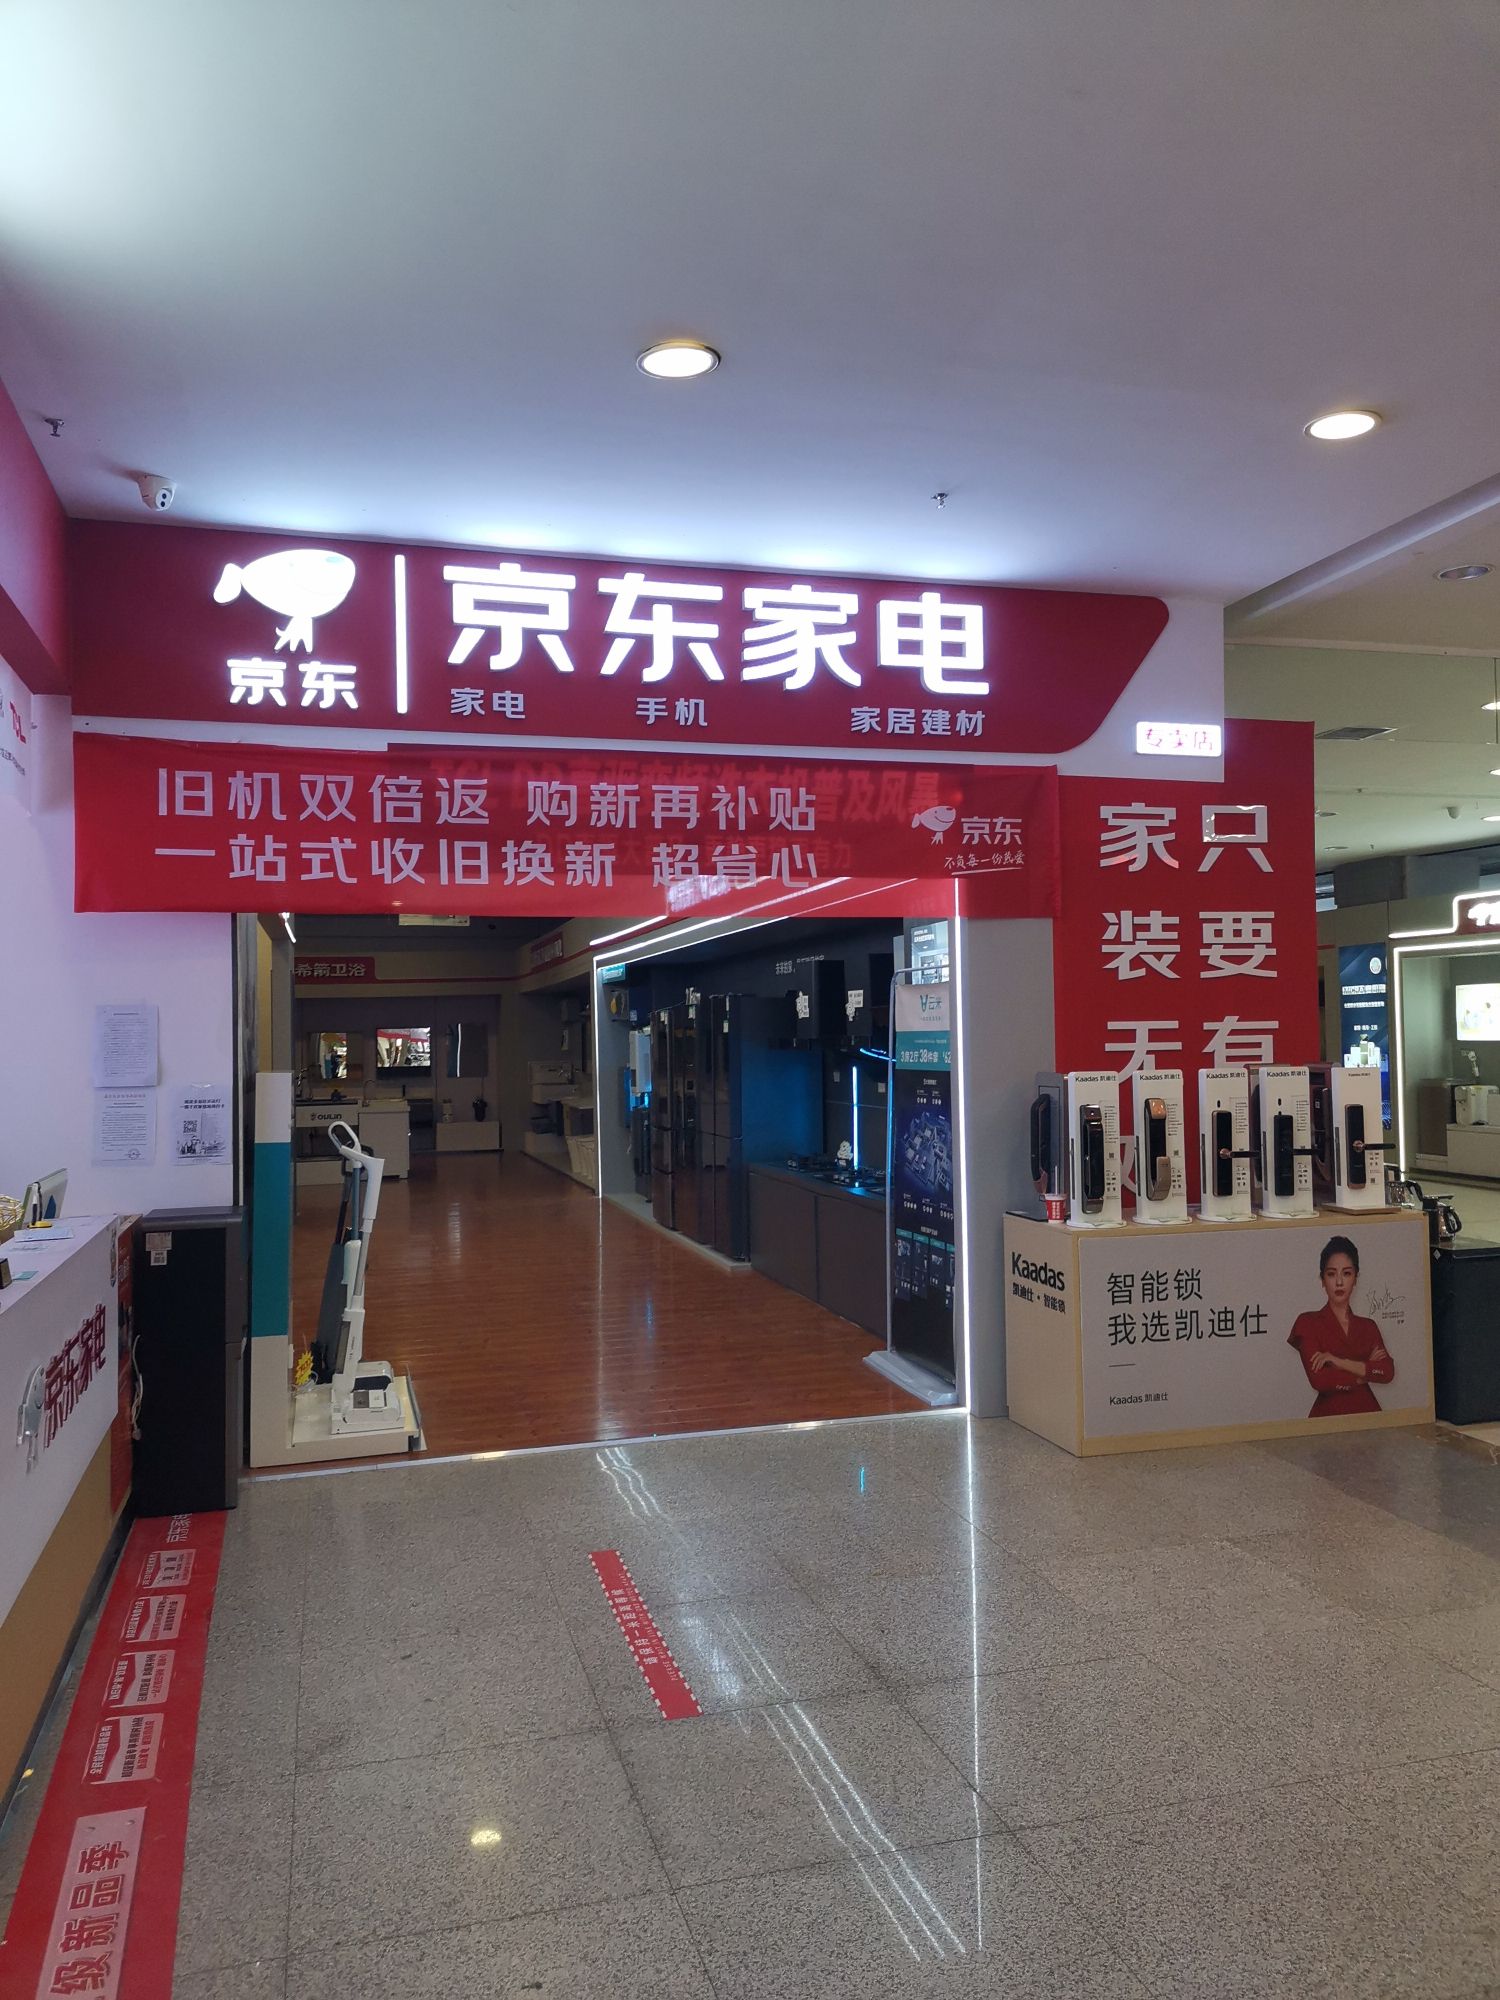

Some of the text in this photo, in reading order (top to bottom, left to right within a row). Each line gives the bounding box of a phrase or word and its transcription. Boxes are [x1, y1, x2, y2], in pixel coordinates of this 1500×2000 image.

[443, 562, 990, 695] 京东家电
[226, 657, 359, 710] 京东
[450, 687, 526, 720] 家电
[635, 697, 708, 728] 手机
[850, 706, 986, 737] 家居建材
[157, 767, 817, 831] 旧机双倍返 购新再补贴
[961, 816, 1022, 845] 京东
[154, 833, 616, 887] 一站式收旧换新
[651, 842, 818, 888] 超省心
[944, 850, 1025, 869] 不负每一份热爱
[295, 963, 366, 977] 希箭卫浴
[1011, 1251, 1065, 1292] Kaadas
[1107, 1268, 1202, 1306] 智能锁
[1107, 1304, 1268, 1347] 我选凯迪仕
[1109, 1392, 1169, 1405] Kaadas 凯迪仕
[50, 1841, 129, 1995] 级新品季
